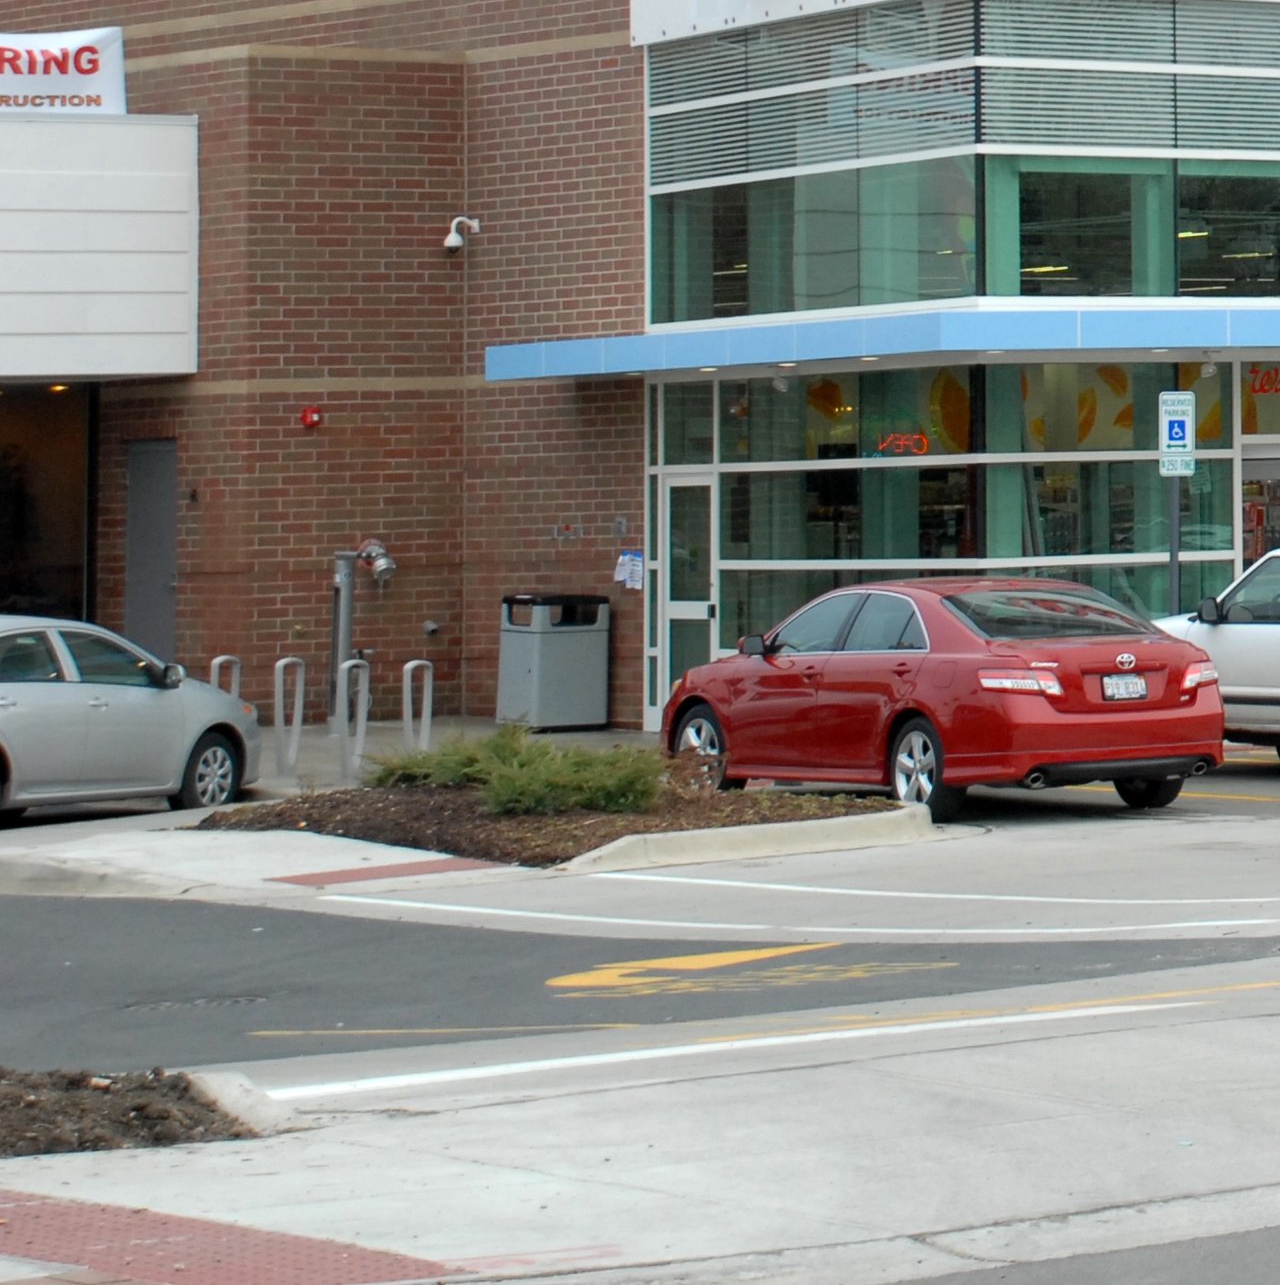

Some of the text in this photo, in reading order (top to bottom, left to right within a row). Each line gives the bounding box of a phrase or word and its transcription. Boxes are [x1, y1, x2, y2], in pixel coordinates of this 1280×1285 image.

[0, 46, 100, 75] RING
[0, 95, 102, 107] RUCTION
[1161, 398, 1192, 407] RESERVED
[1163, 408, 1190, 417] PARKING
[1180, 459, 1194, 472] FINE
